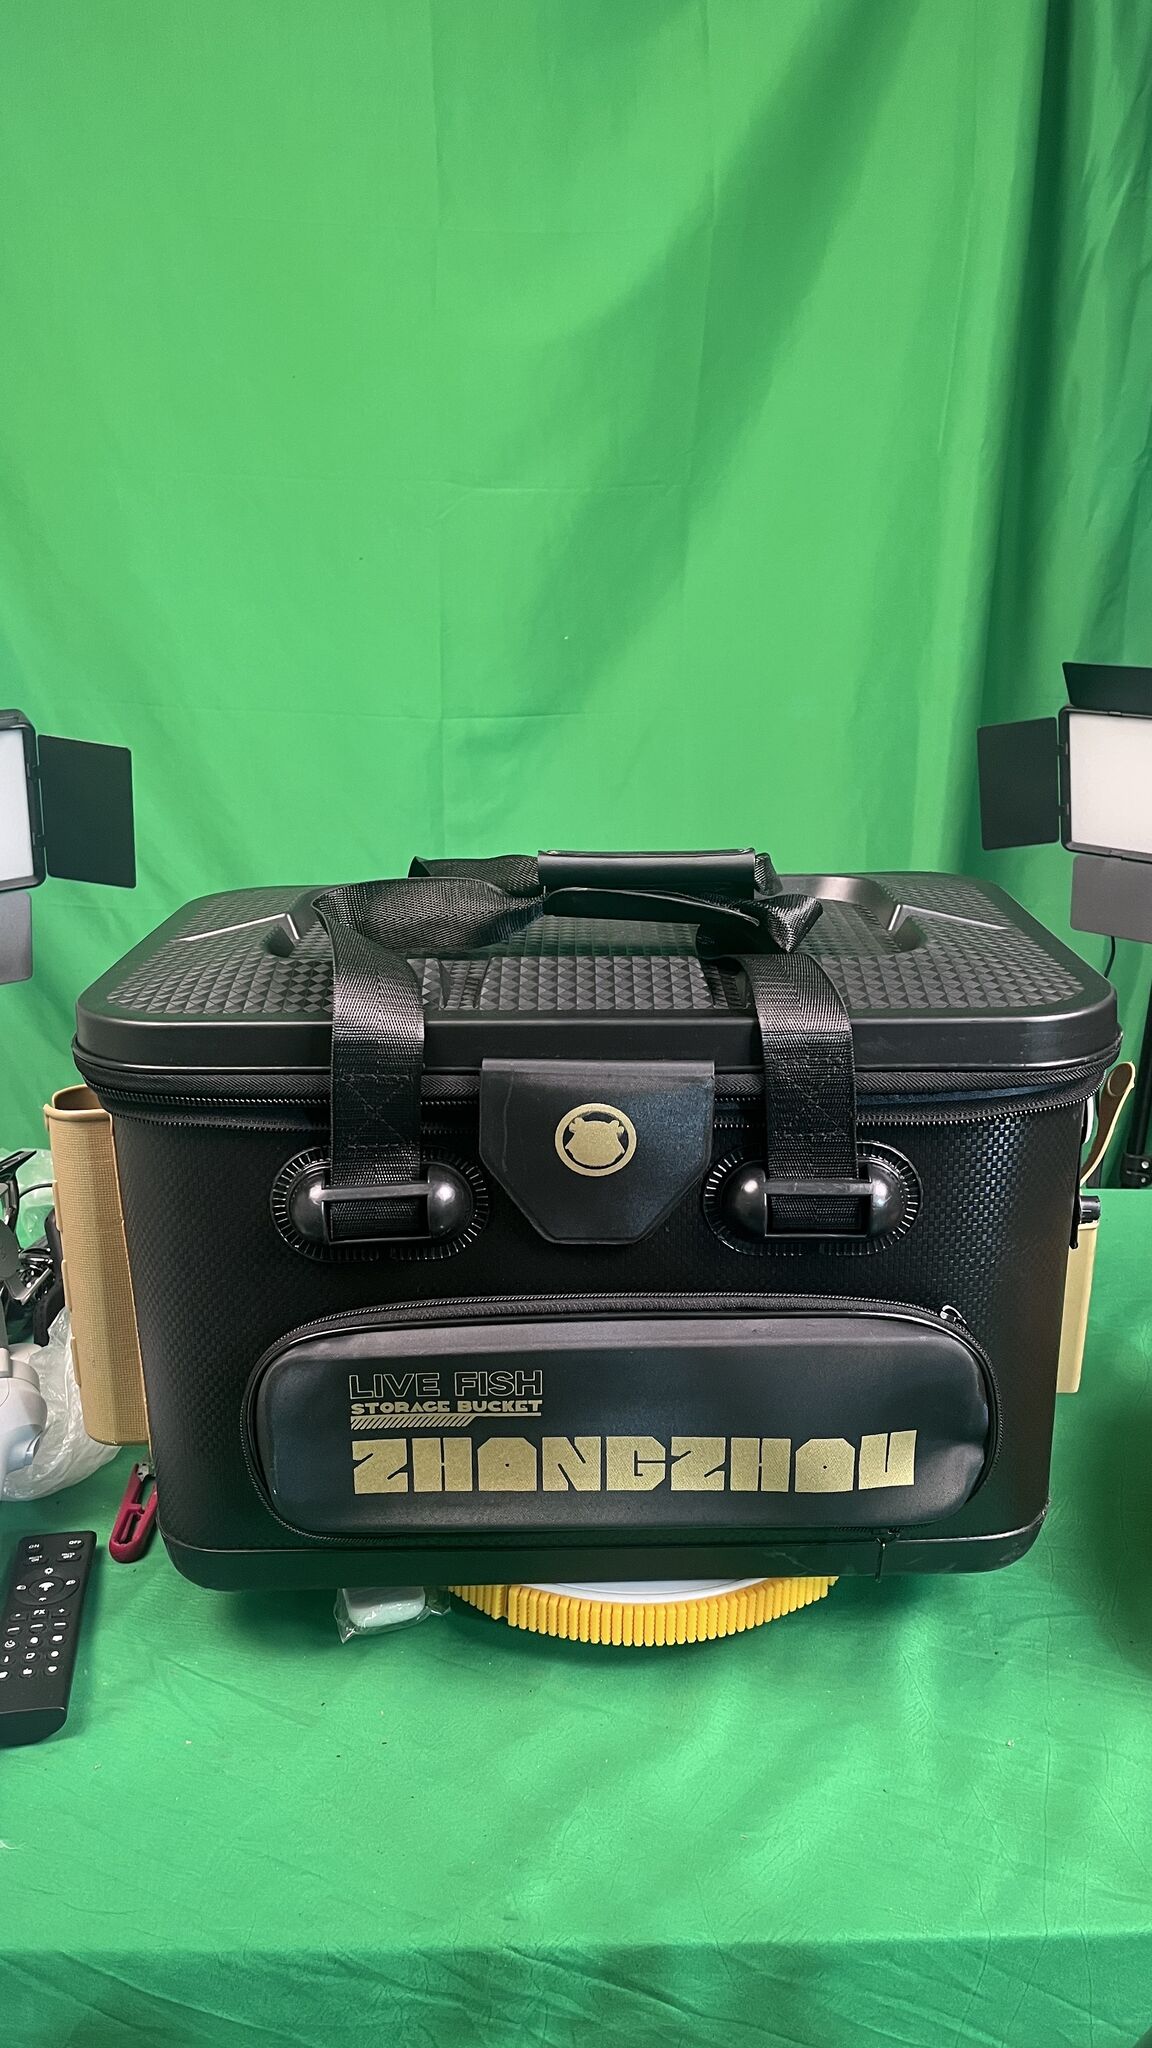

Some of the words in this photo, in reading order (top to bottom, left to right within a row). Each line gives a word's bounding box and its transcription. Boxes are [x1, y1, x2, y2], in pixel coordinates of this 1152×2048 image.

[349, 1373, 440, 1399] LIVE
[454, 1370, 543, 1397] FISH
[351, 1401, 450, 1415] STORAGE
[457, 1400, 543, 1413] BUCKET
[352, 1429, 918, 1495] ZHONGZHOU
